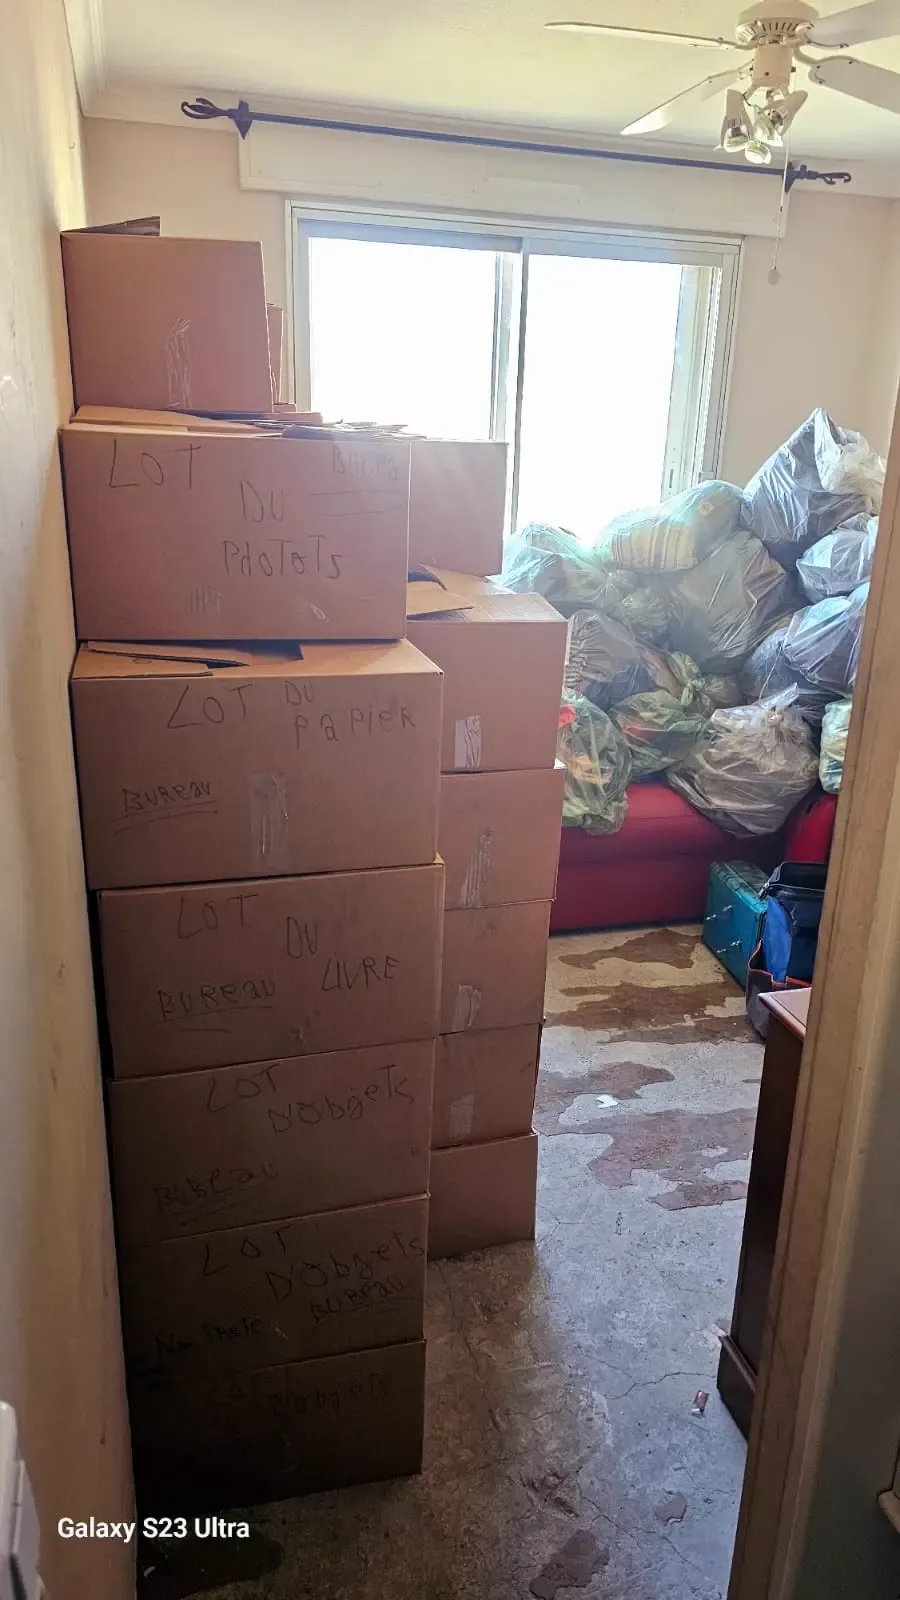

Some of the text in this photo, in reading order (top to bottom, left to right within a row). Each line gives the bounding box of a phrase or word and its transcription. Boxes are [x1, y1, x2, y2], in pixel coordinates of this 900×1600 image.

[108, 439, 202, 489] LOT
[239, 480, 285, 523] DU
[167, 680, 314, 729] LOT DU
[177, 894, 259, 939] LOT
[286, 915, 318, 958] DU
[207, 1064, 280, 1113] LOT
[202, 1225, 292, 1277] LOT
